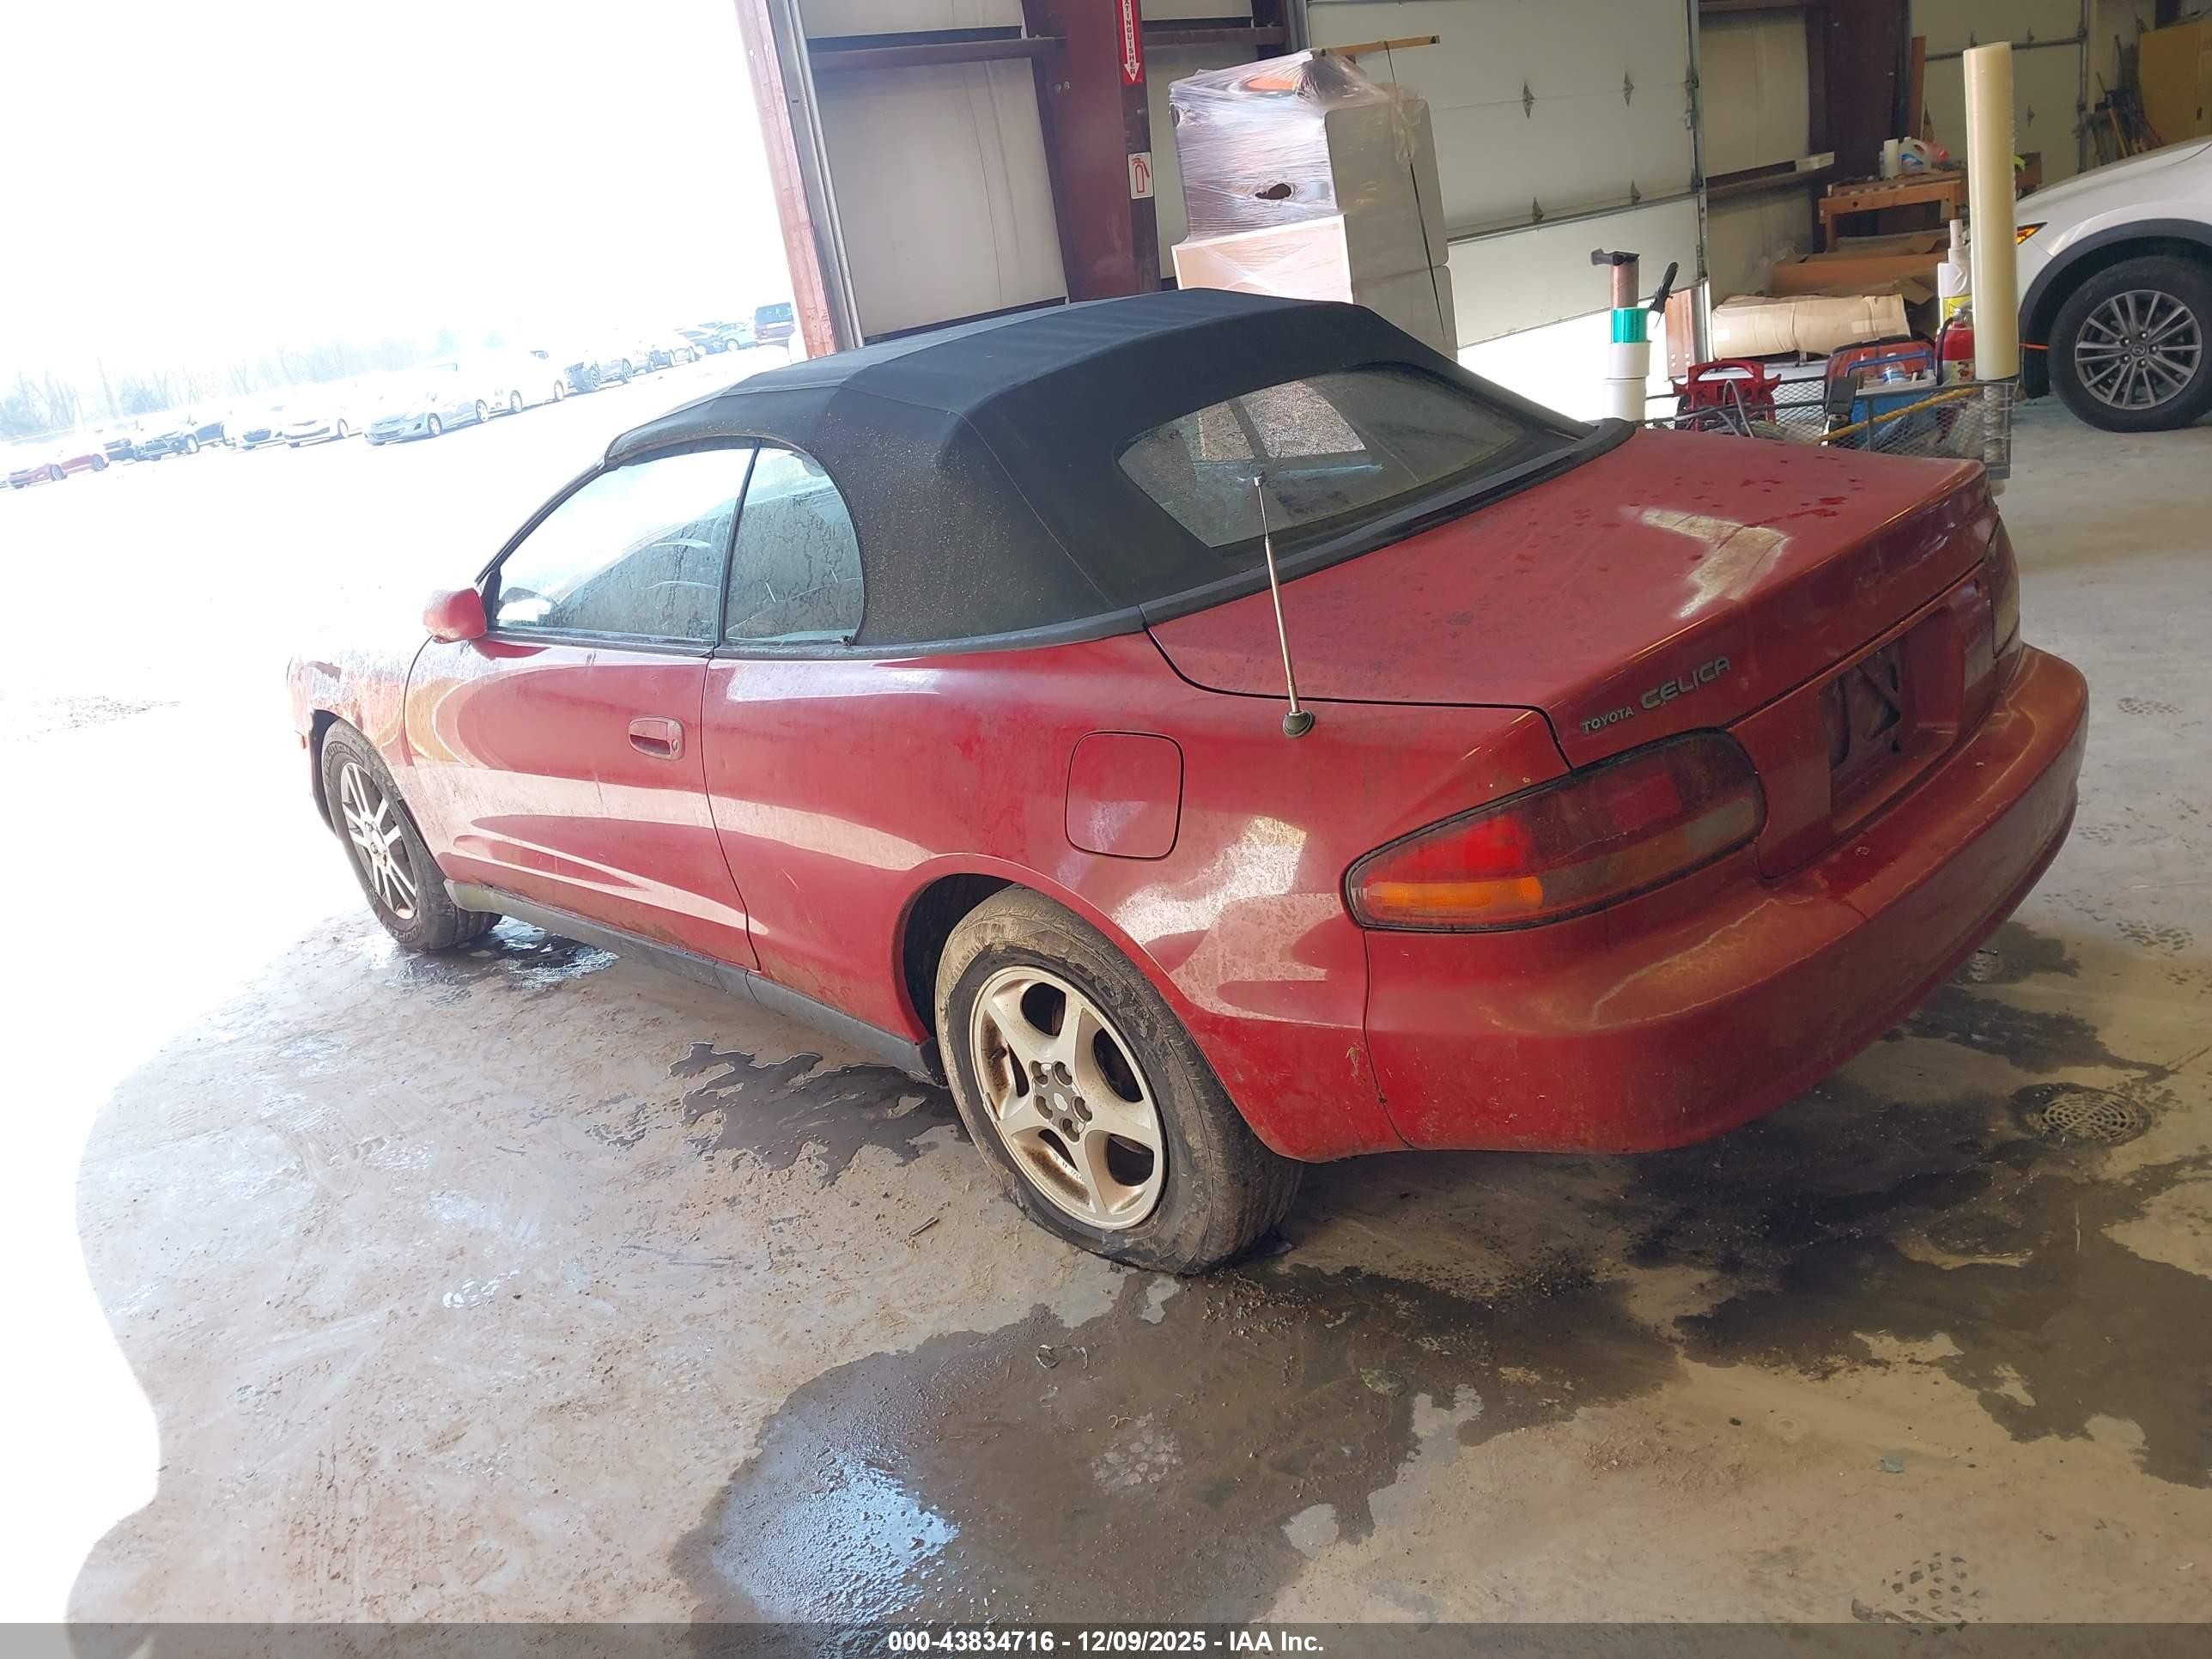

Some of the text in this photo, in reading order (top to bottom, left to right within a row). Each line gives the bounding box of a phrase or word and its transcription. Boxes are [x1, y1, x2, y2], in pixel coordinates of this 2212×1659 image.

[1125, 0, 1135, 74] XTINGUISHER
[1581, 657, 1730, 733] TOYOTA CELICA
